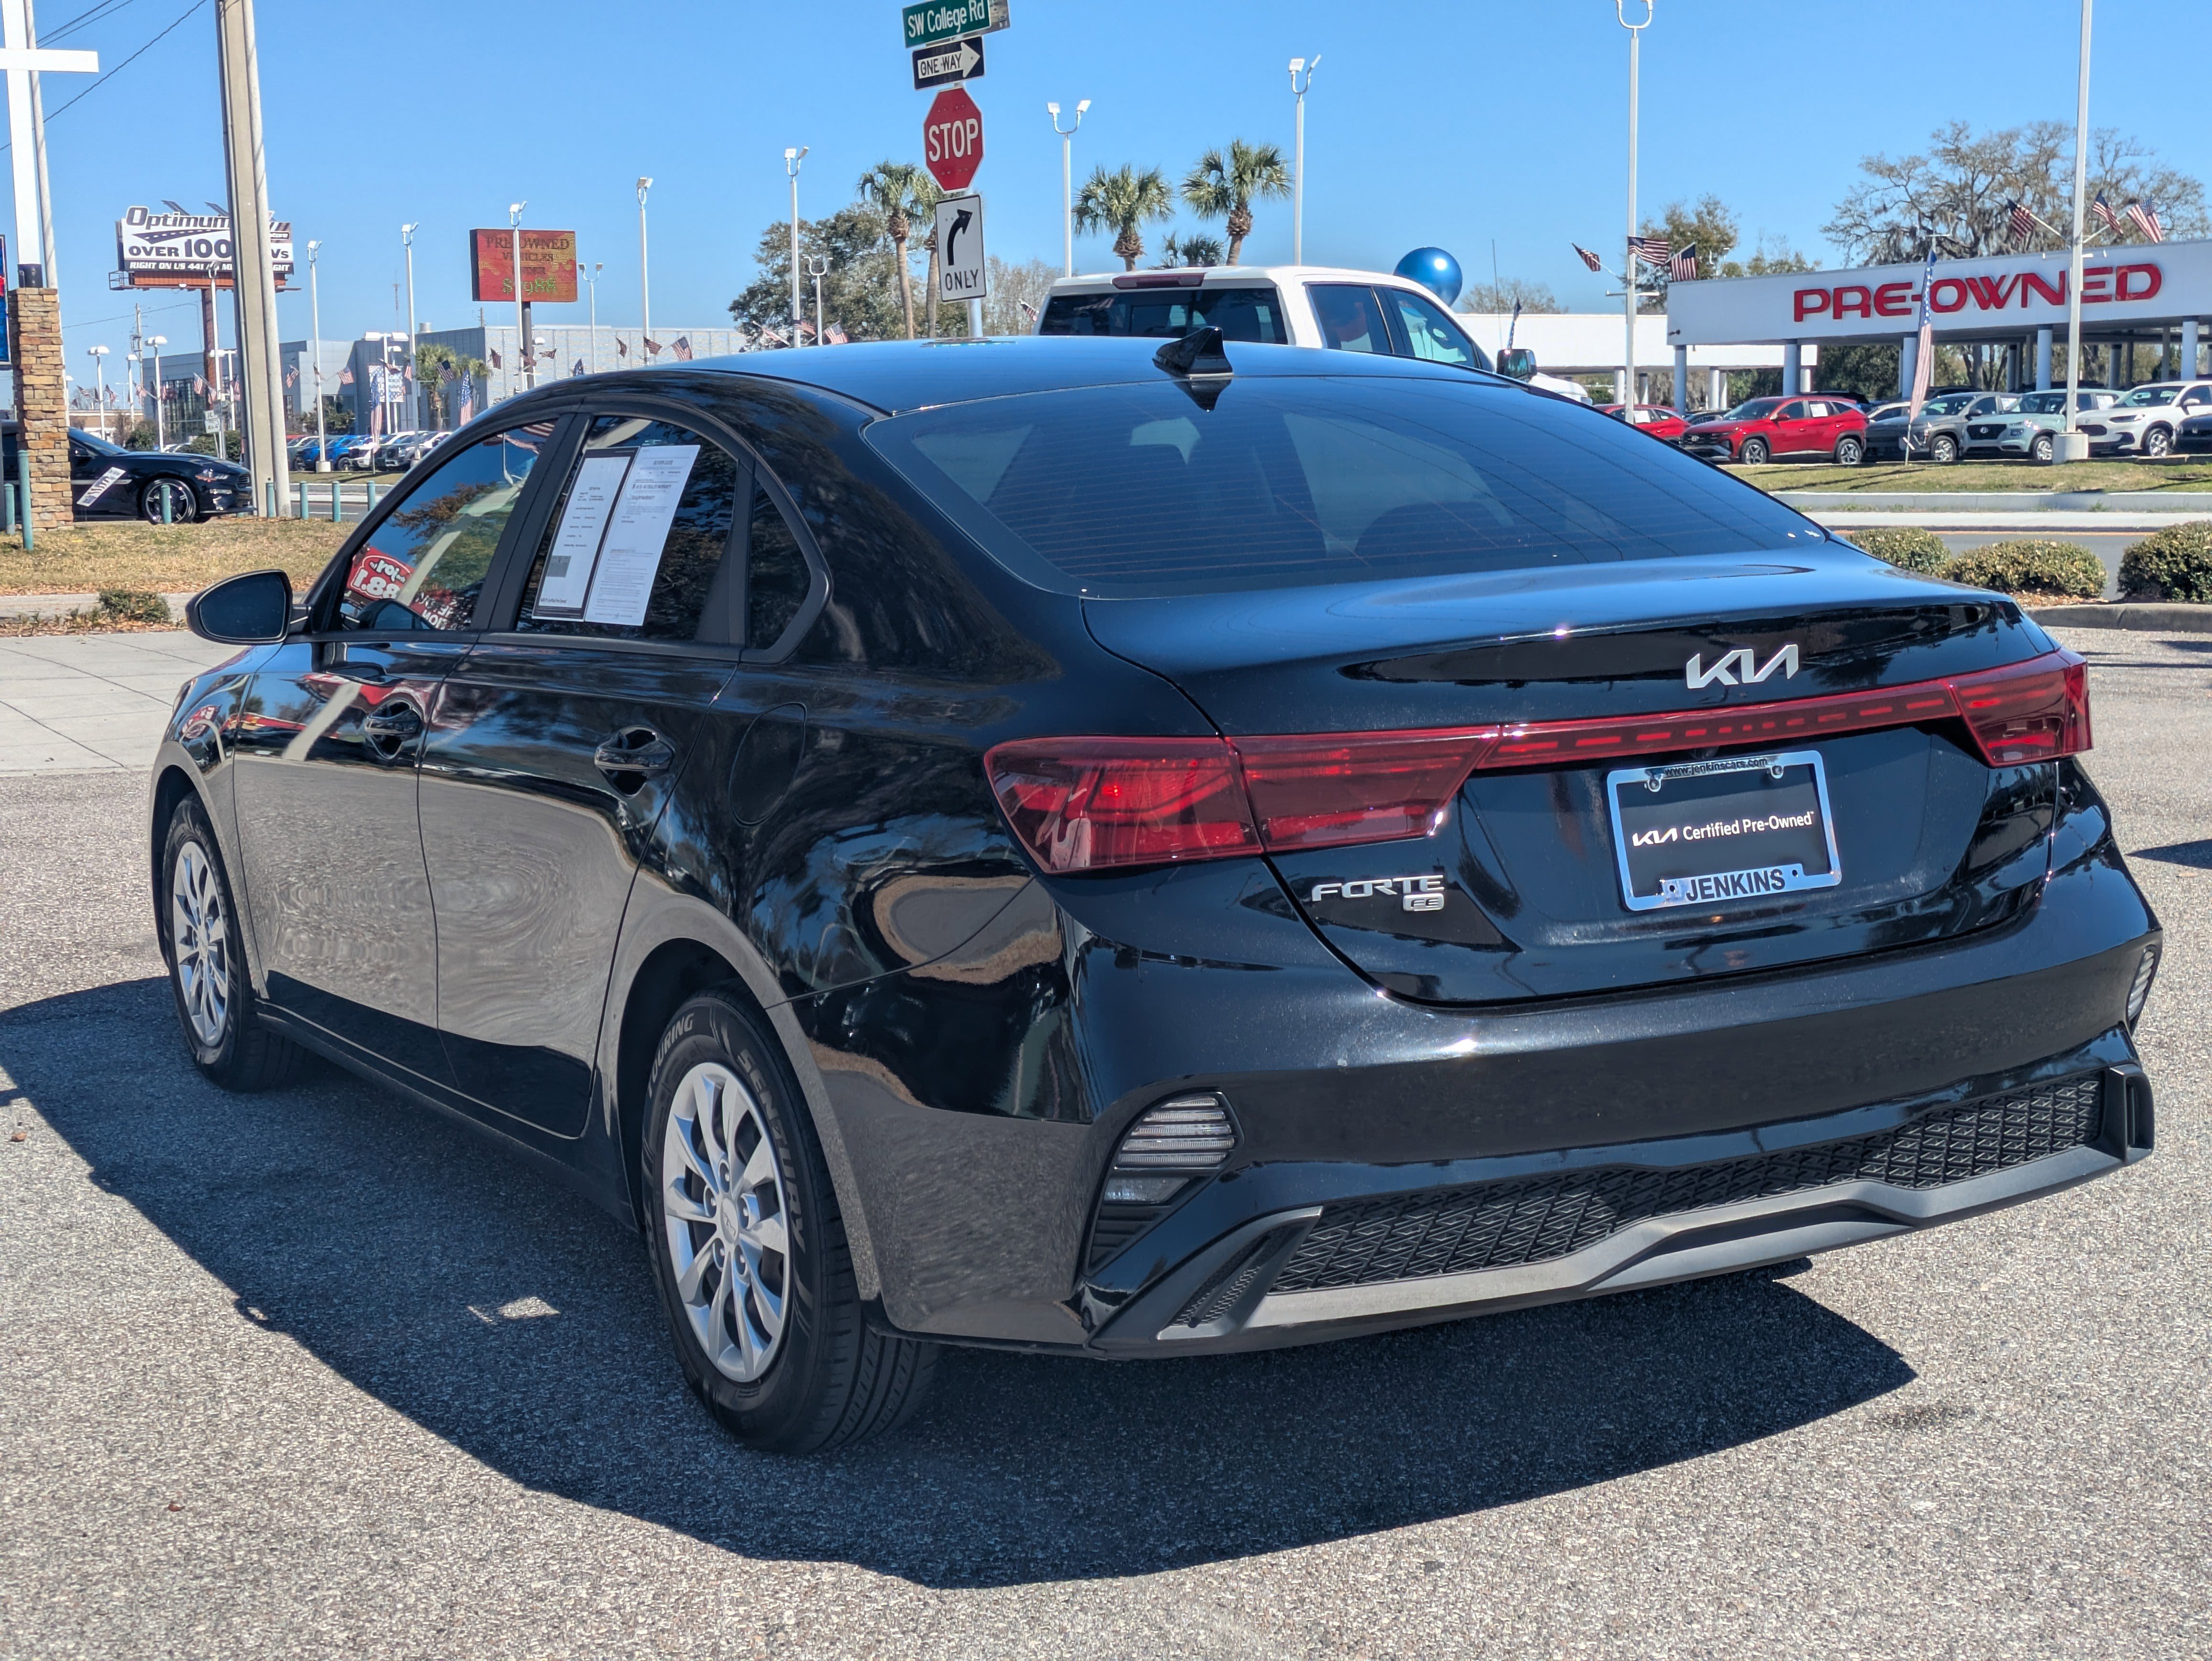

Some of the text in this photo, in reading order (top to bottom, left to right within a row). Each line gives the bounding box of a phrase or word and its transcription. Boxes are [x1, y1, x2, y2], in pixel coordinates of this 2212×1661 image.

[908, 0, 985, 38] SW College Rd
[920, 53, 962, 76] ONE WAY
[929, 118, 979, 162] STOP
[126, 207, 230, 230] Optimum
[129, 245, 179, 257] OVER
[271, 248, 289, 259] Vs
[130, 261, 157, 269] RIGHT
[945, 269, 979, 291] ONLY
[1793, 263, 2162, 322] PRE-OWNED
[1686, 643, 1799, 689] KIA
[1664, 757, 1769, 777] www.jenkinscars.com
[1632, 827, 1678, 847] KIA
[1682, 820, 1740, 841] Certified
[1312, 875, 1445, 901] FORTE
[1686, 868, 1785, 901] JENKINS
[647, 1012, 695, 1099] TOURING
[737, 1048, 806, 1254] SENTURY
